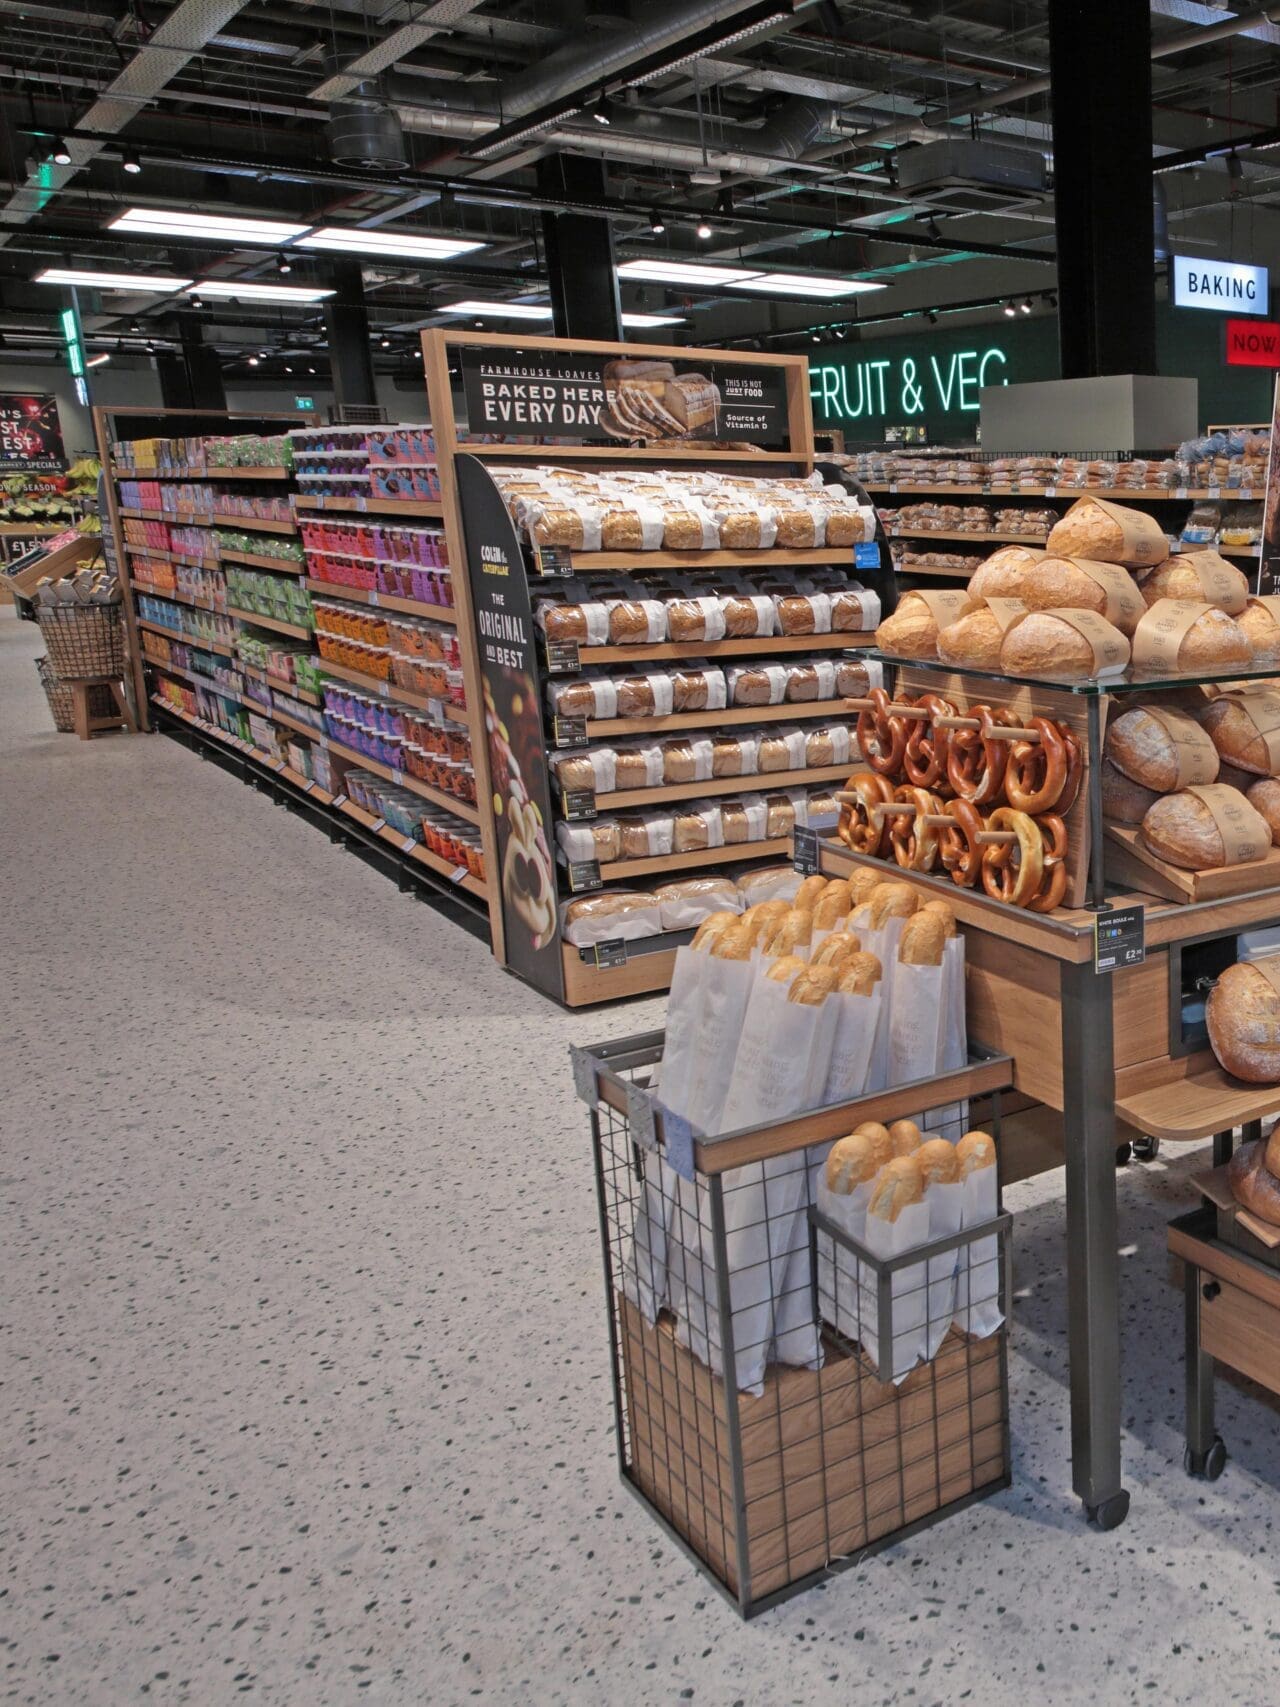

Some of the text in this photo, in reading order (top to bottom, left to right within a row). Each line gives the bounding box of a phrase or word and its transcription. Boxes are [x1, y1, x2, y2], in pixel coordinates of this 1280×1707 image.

[1188, 273, 1257, 300] BAKING
[1233, 333, 1276, 354] NOW
[481, 365, 601, 381] FARMHOUSE LOAVES
[725, 379, 740, 387] THIS
[808, 349, 1008, 418] FRUIT & VEG
[483, 383, 617, 402] BAKED HERE
[744, 388, 763, 397] FOOD
[485, 401, 603, 425] EVERY DAY
[726, 421, 759, 429] Vitamin
[27, 461, 62, 469] SPECIALS
[23, 483, 57, 491] SEASON
[491, 593, 504, 606] THE
[479, 610, 527, 644] ORIGINAL
[486, 645, 523, 669] AND BEST
